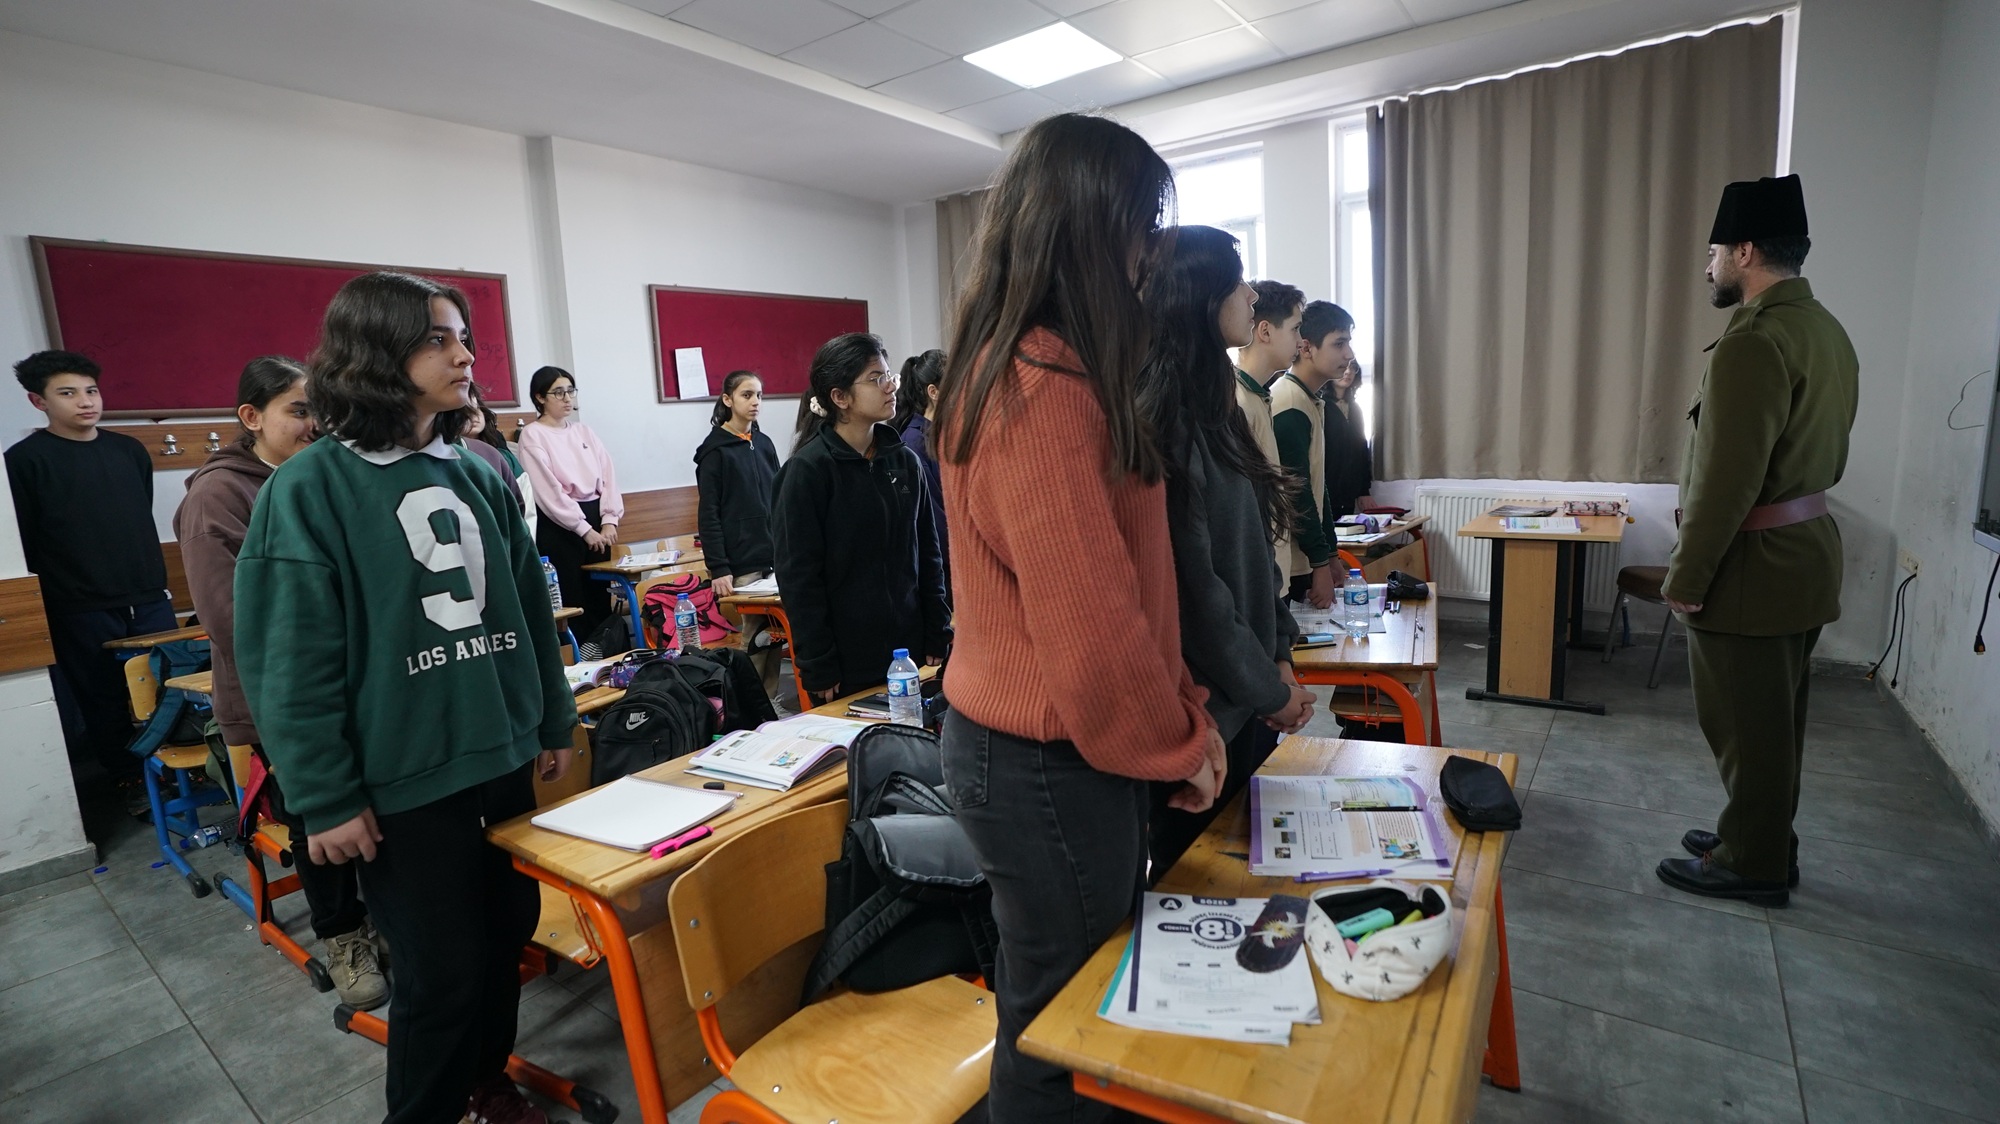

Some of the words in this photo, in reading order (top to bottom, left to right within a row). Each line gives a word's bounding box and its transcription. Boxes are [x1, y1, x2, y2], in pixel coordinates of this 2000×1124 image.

[396, 486, 486, 632] 9
[406, 646, 447, 676] LOS
[455, 631, 517, 661] ANES
[629, 711, 646, 723] NIKE
[1163, 899, 1179, 910] A
